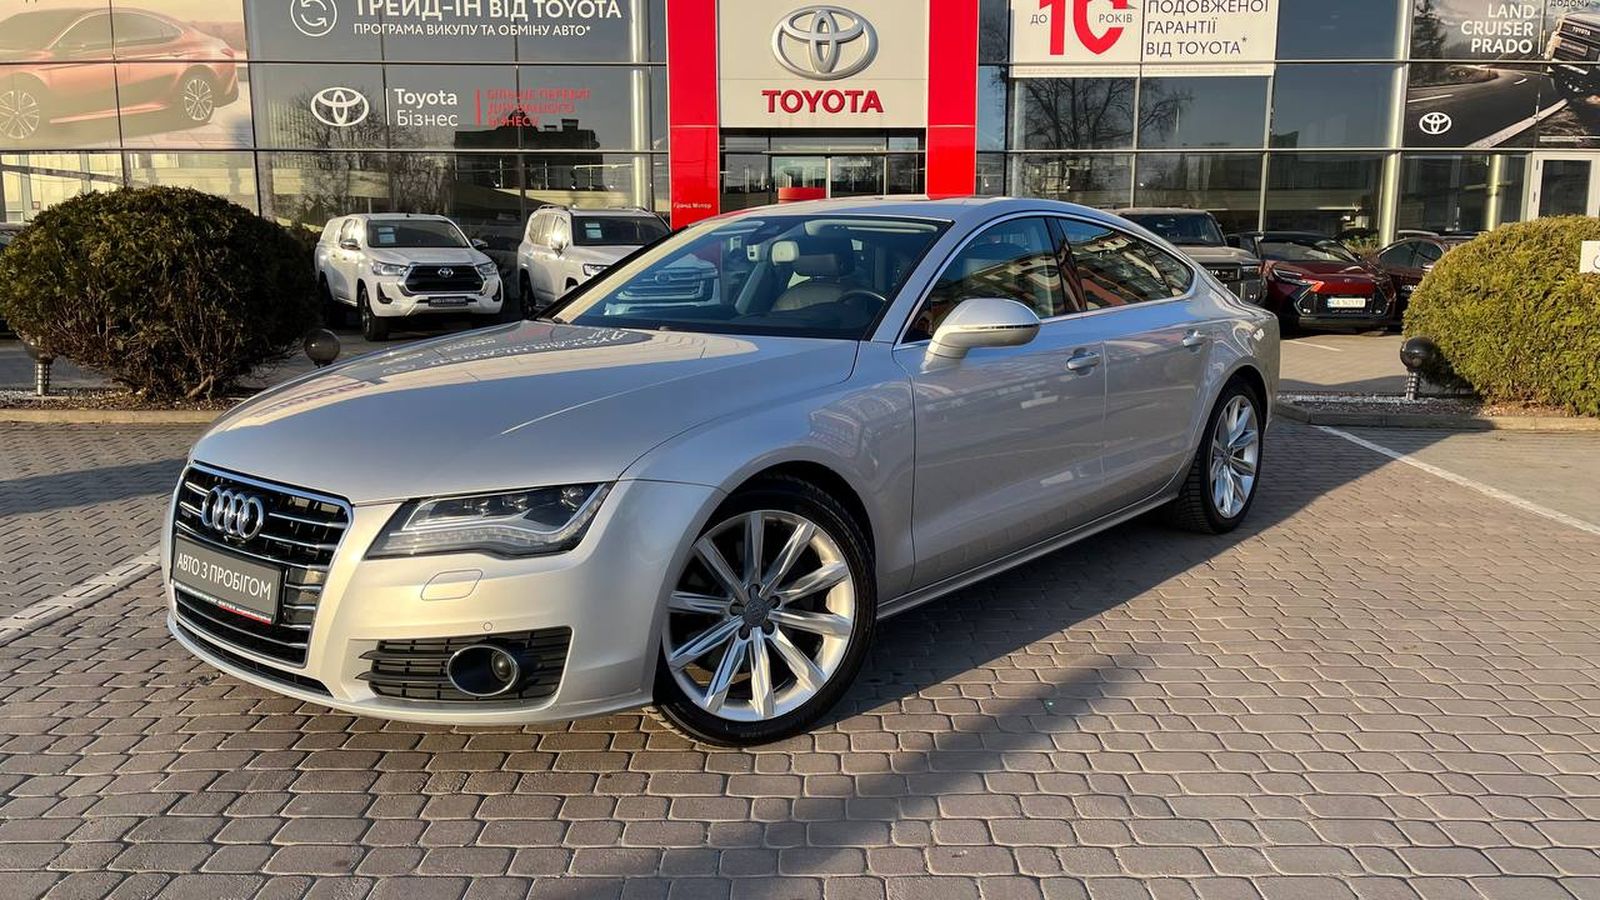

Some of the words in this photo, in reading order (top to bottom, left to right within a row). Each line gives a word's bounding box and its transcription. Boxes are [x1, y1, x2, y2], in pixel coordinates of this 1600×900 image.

[490, 0, 529, 22] ВІД
[533, 0, 622, 18] TOYOTA
[1030, 14, 1048, 25] ДО
[1098, 13, 1133, 24] РОКІВ
[1487, 3, 1535, 19] LAND
[353, 23, 424, 36] ПРОГРАМА
[426, 24, 478, 36] ВИКУПУ
[481, 24, 496, 36] ТА
[498, 24, 550, 36] ОБМІНУ
[1147, 17, 1218, 34] ГАРАНТІЇ
[1460, 20, 1534, 36] CRUISER
[1146, 42, 1172, 57] ВІД
[1470, 38, 1533, 54] PRADO
[393, 88, 458, 109] Toyota
[761, 90, 884, 114] TOYOTA
[396, 109, 459, 127] Бізнес
[177, 553, 200, 575] АВТО
[200, 562, 208, 579] З
[209, 564, 272, 600] ПРОБІГОМ
